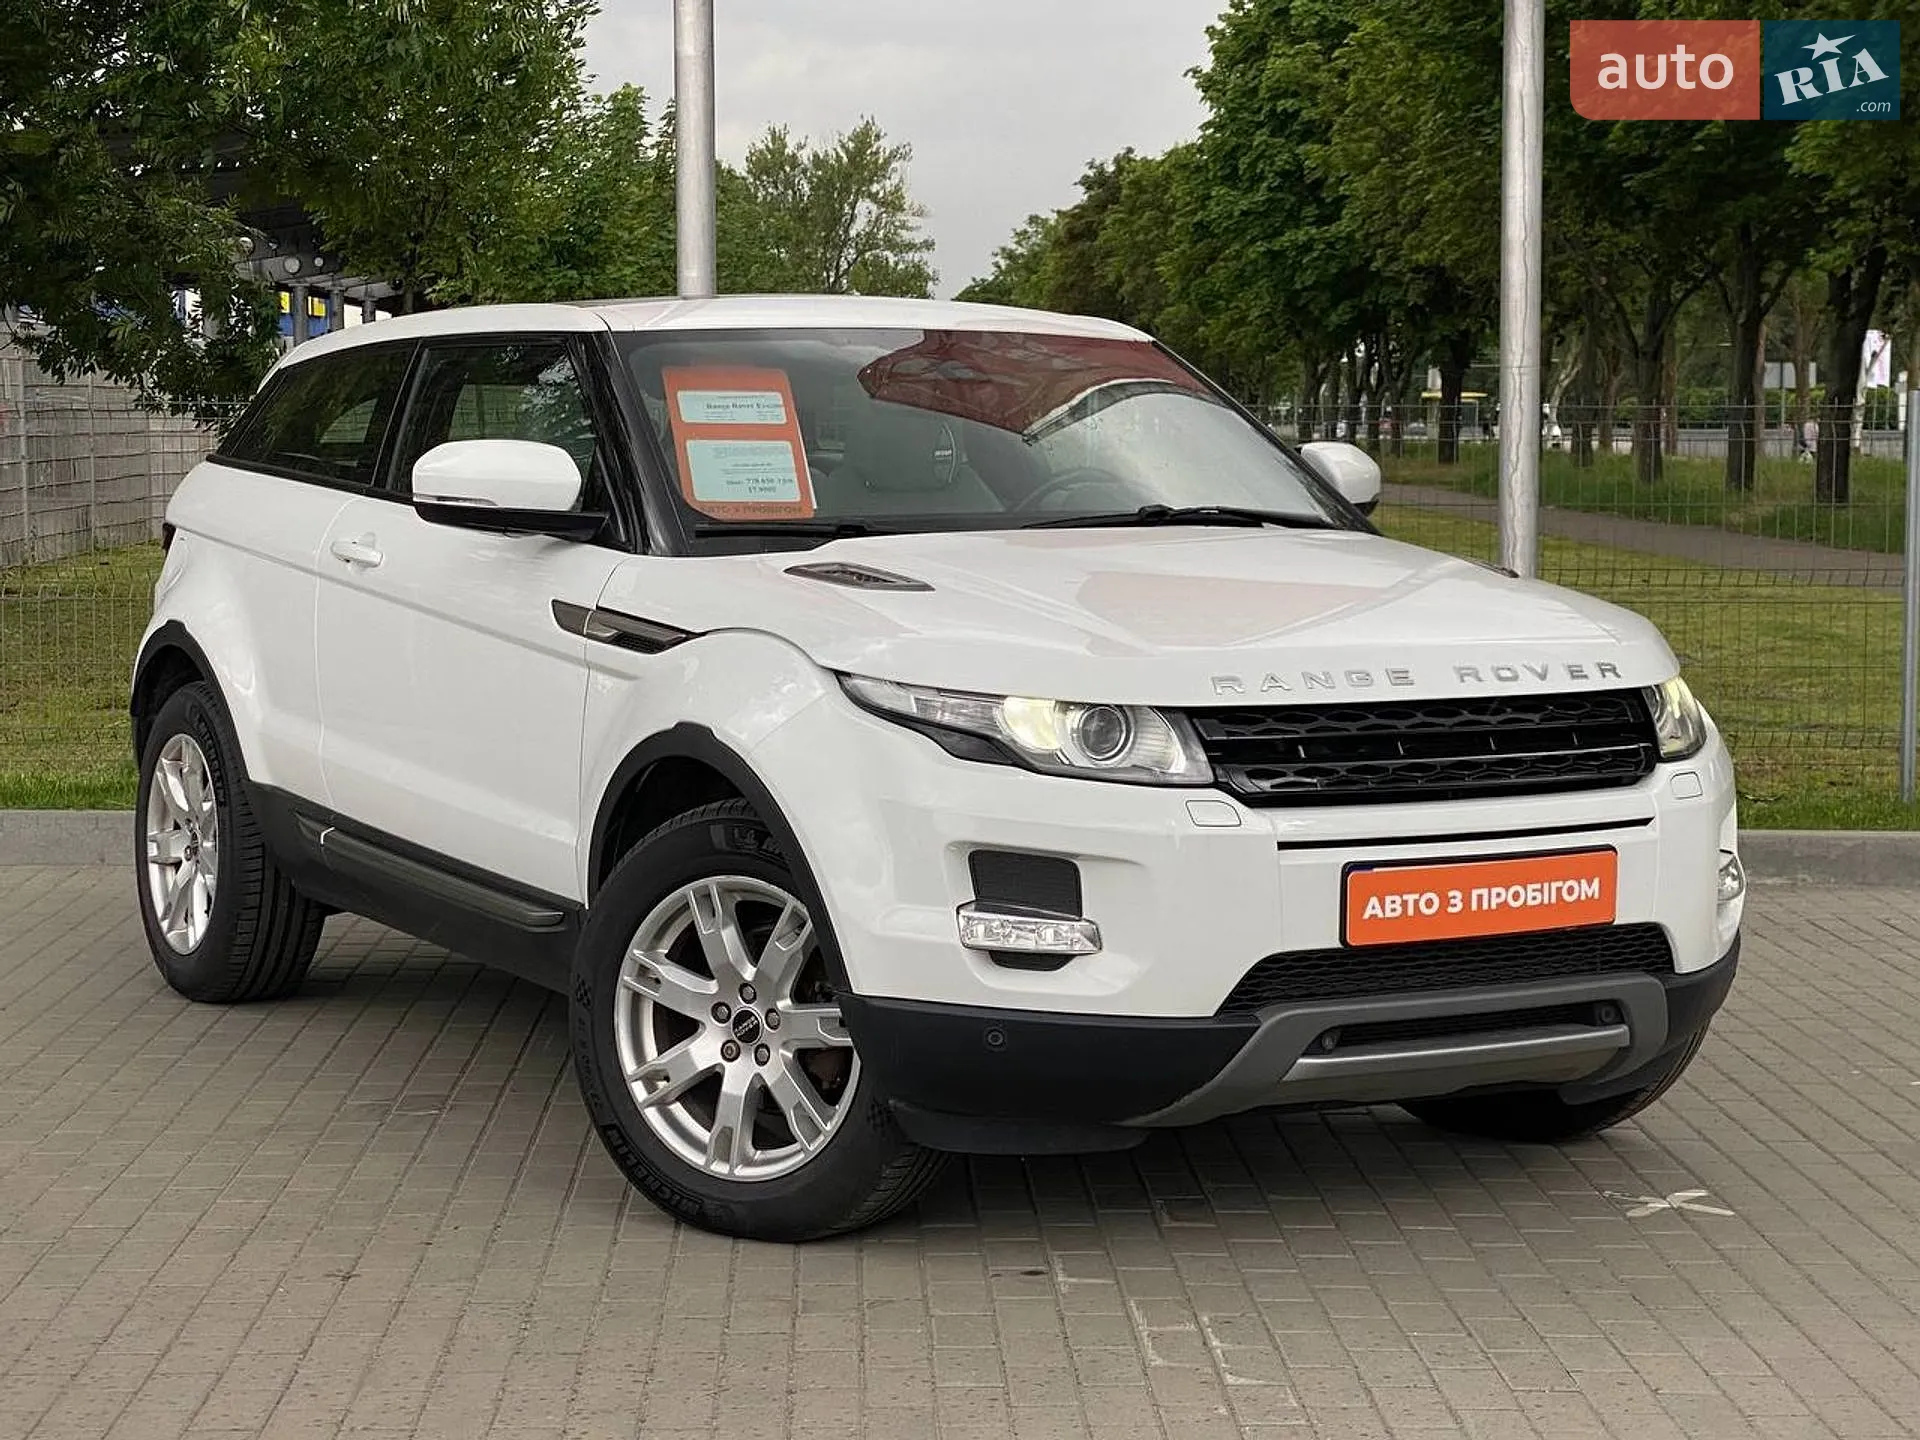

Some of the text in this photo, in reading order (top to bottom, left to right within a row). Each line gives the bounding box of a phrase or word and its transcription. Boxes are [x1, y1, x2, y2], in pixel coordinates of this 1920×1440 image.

[1211, 660, 1622, 696] RANGE ROVER
[1362, 876, 1601, 920] АВТО З ПРОБІГОМ
